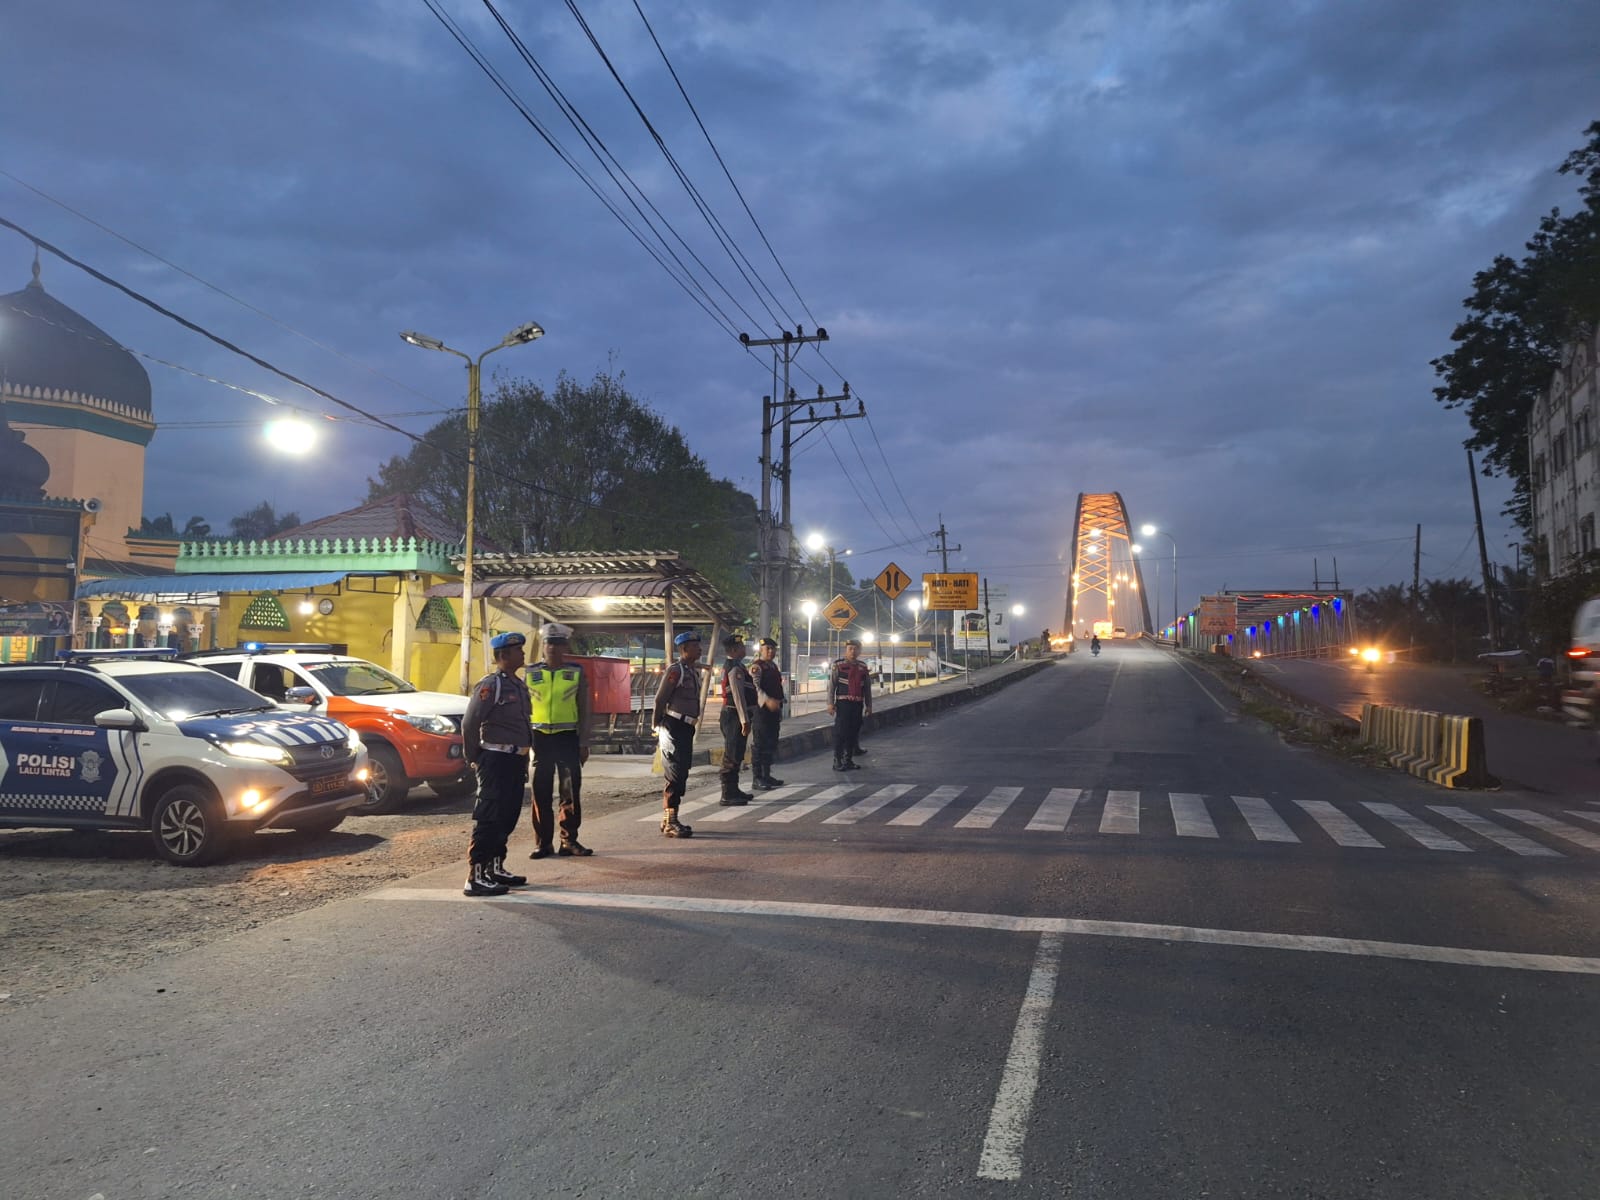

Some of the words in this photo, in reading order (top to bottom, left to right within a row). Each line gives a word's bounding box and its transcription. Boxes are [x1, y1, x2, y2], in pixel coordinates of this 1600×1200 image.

[931, 579, 947, 587] HATI
[953, 579, 969, 587] HATI
[17, 753, 75, 769] POLISI
[19, 767, 40, 775] LALU
[41, 768, 71, 777] LINTAS
